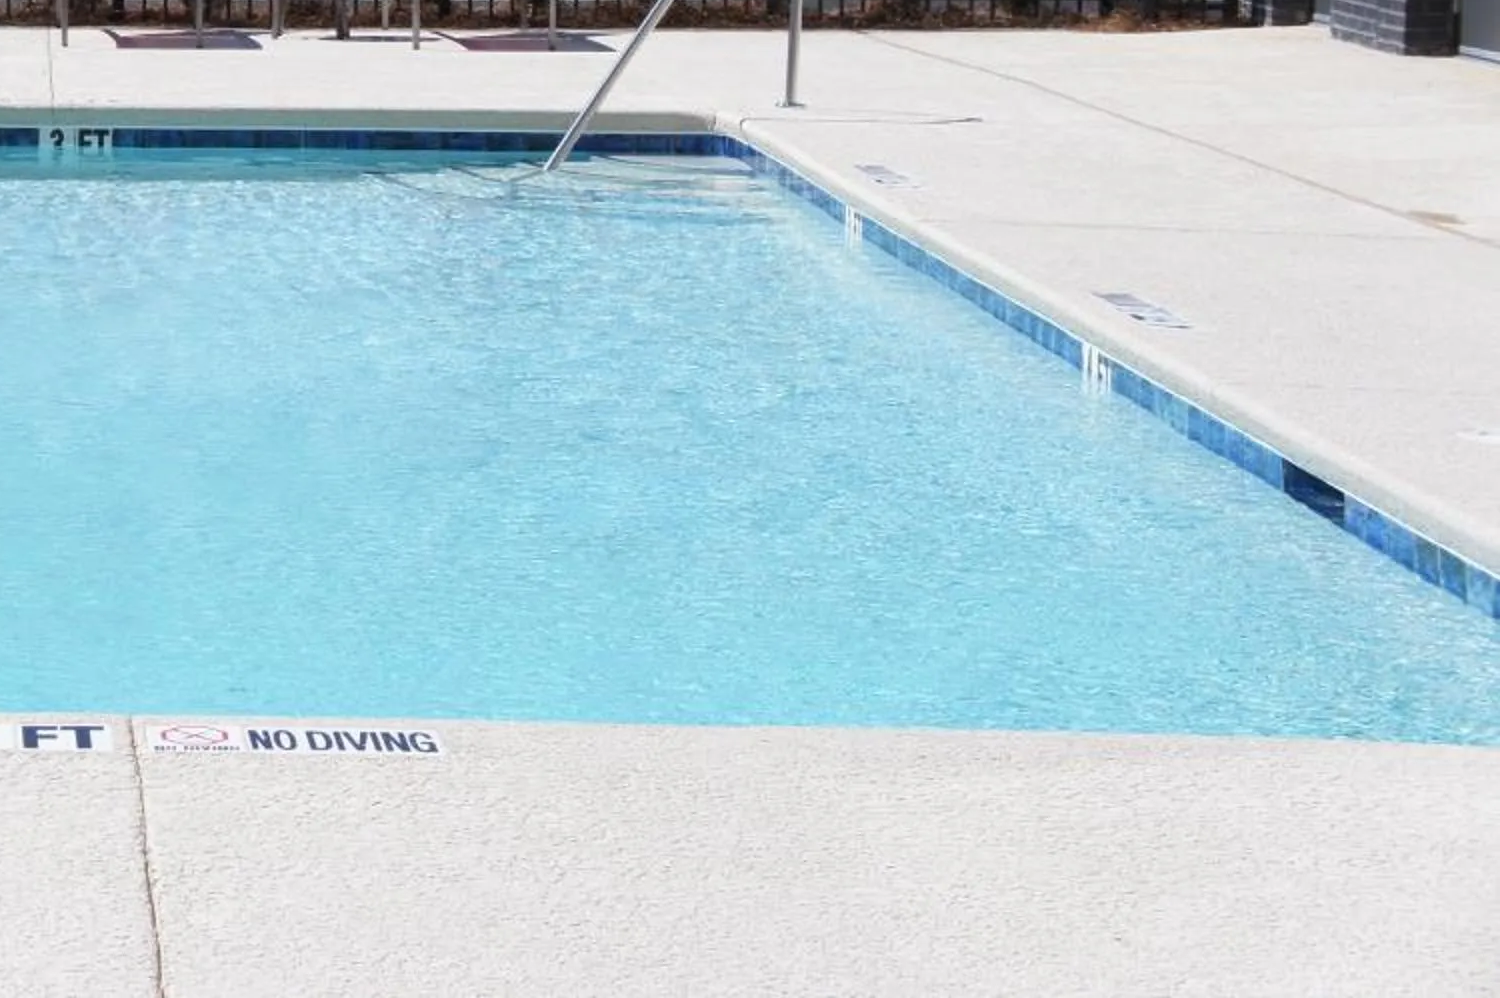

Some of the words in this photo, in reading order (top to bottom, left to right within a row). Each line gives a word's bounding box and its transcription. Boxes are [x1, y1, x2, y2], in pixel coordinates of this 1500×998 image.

[77, 128, 110, 147] FT
[21, 725, 104, 749] FT
[248, 729, 297, 751] NO
[305, 730, 439, 753] DIVING
